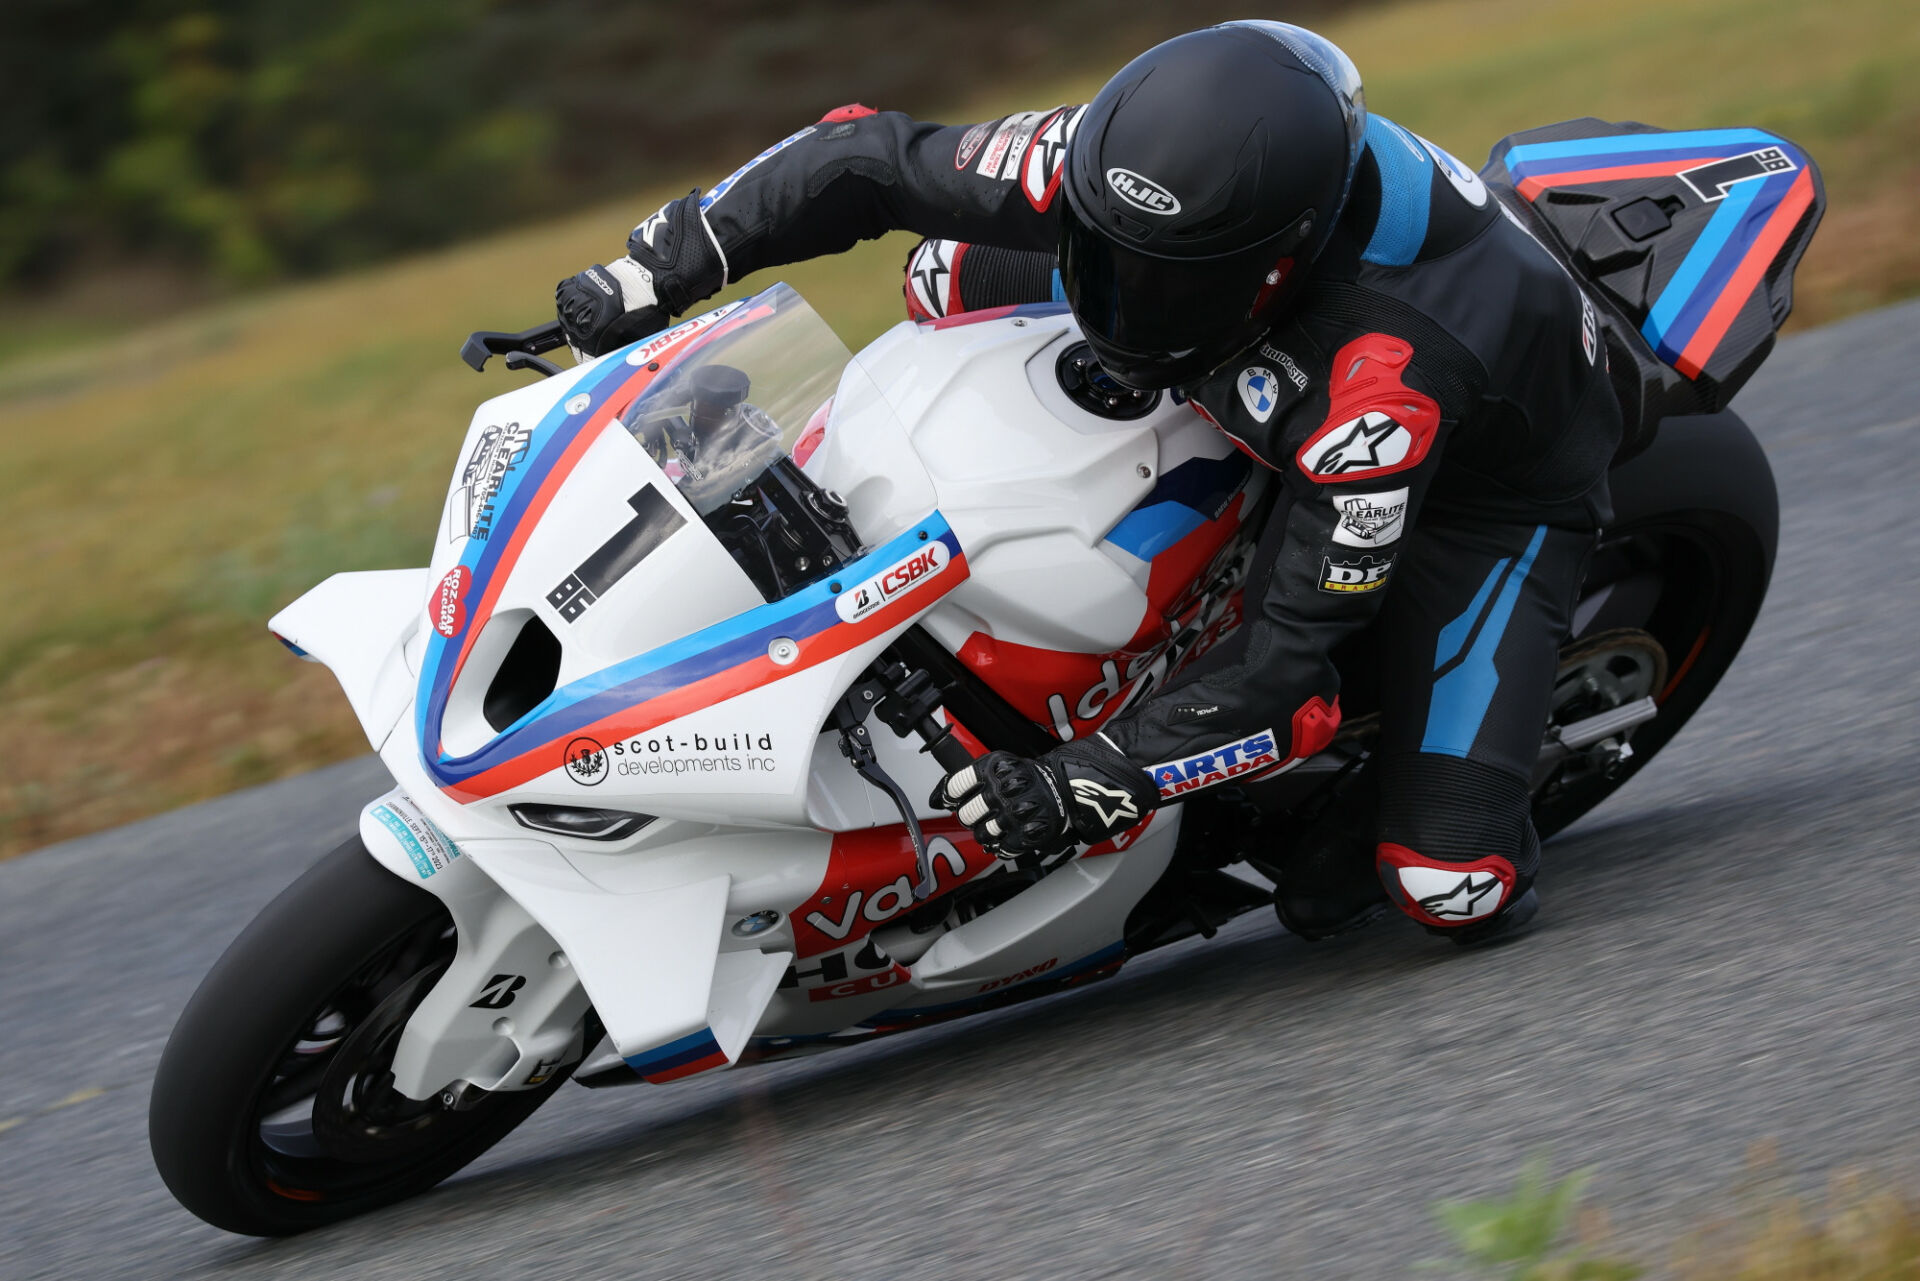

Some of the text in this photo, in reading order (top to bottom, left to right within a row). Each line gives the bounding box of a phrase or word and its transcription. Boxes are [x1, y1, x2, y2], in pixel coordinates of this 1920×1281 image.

[1113, 173, 1173, 211] HJC
[1676, 152, 1769, 202] 1
[640, 320, 699, 360] CSBK
[1246, 368, 1279, 394] BMW
[477, 422, 520, 541] CLEARLITE
[574, 482, 688, 599] 1
[882, 547, 938, 594] CSBK
[438, 575, 452, 631] Racing
[445, 569, 461, 635] ROZ-GAR
[614, 733, 773, 755] scot-build
[617, 753, 776, 776] developments inc
[1145, 734, 1274, 788] ARTS
[1158, 754, 1276, 798] ANADA
